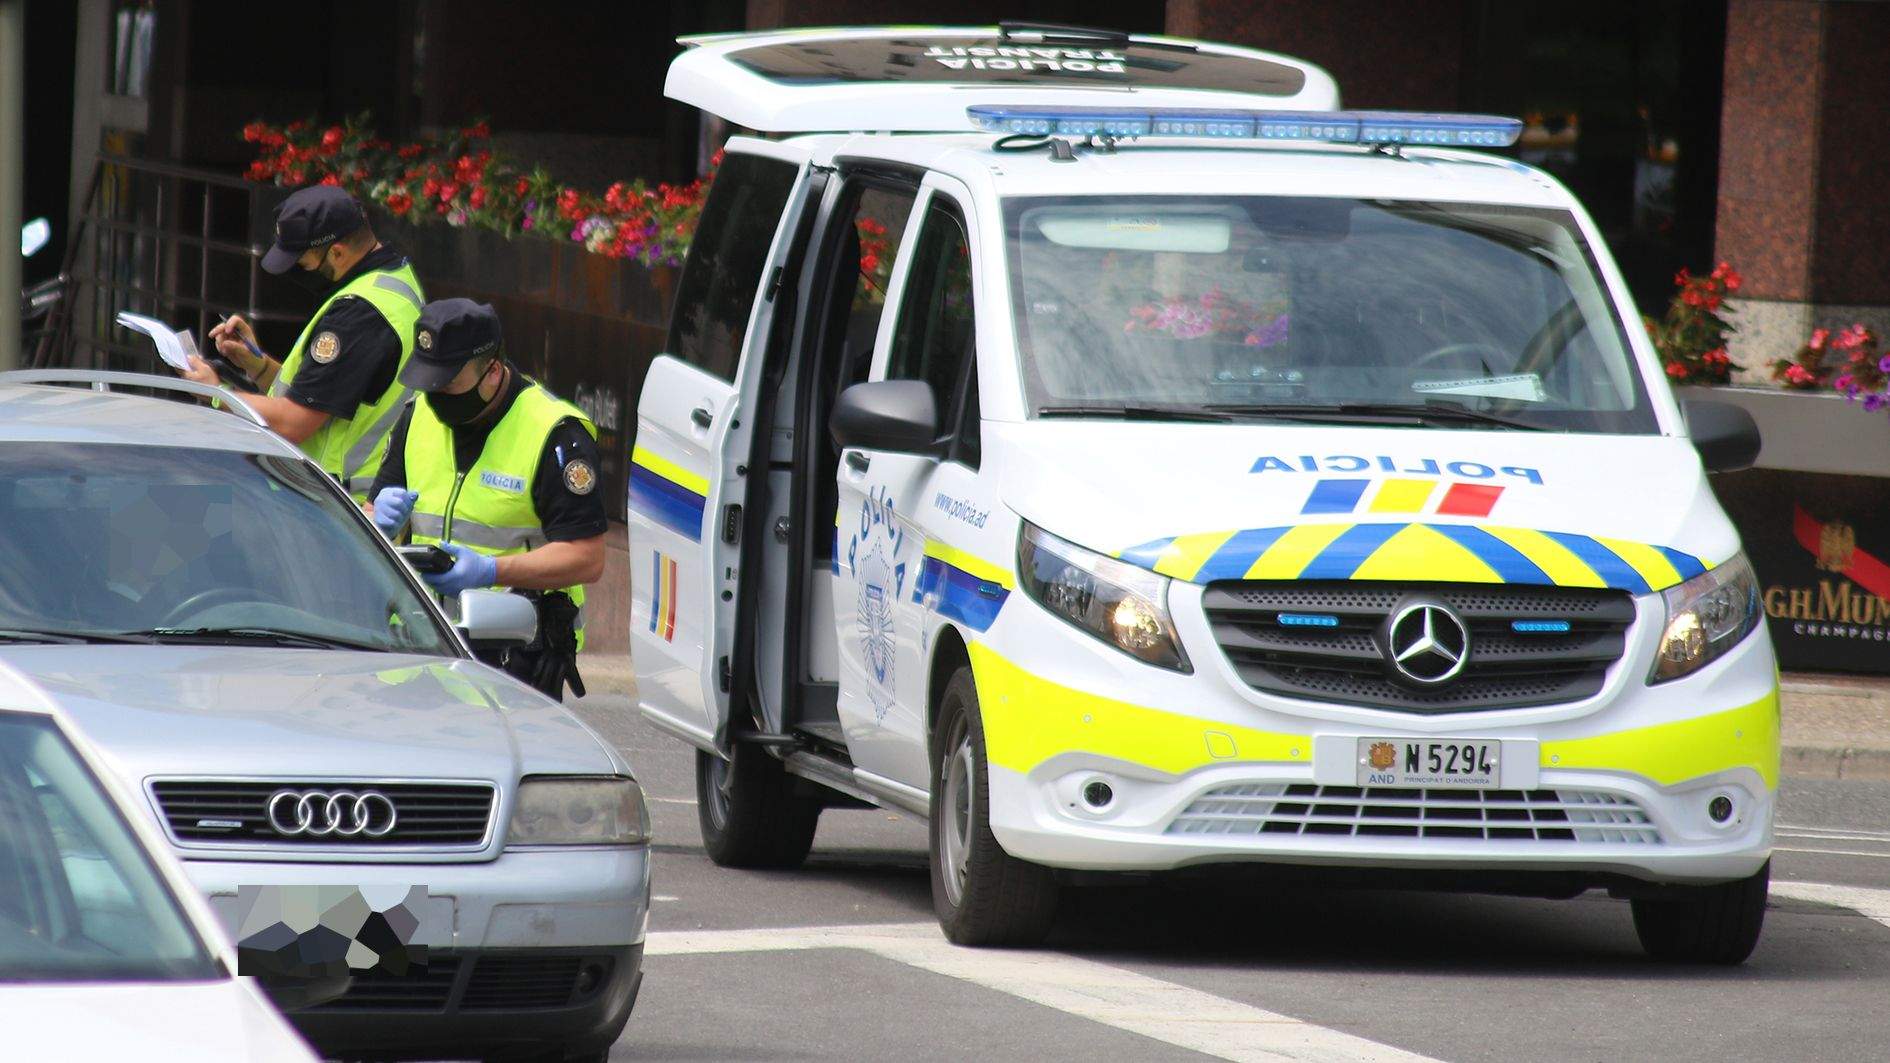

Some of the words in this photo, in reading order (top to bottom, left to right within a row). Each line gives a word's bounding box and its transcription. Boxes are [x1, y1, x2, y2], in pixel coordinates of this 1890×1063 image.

[923, 47, 1126, 61] TRANSIT
[936, 58, 1126, 73] POLICIA
[934, 491, 991, 529] www.policia.ad
[1405, 744, 1420, 773] N
[1428, 744, 1491, 775] 5294
[1368, 774, 1395, 785] AND
